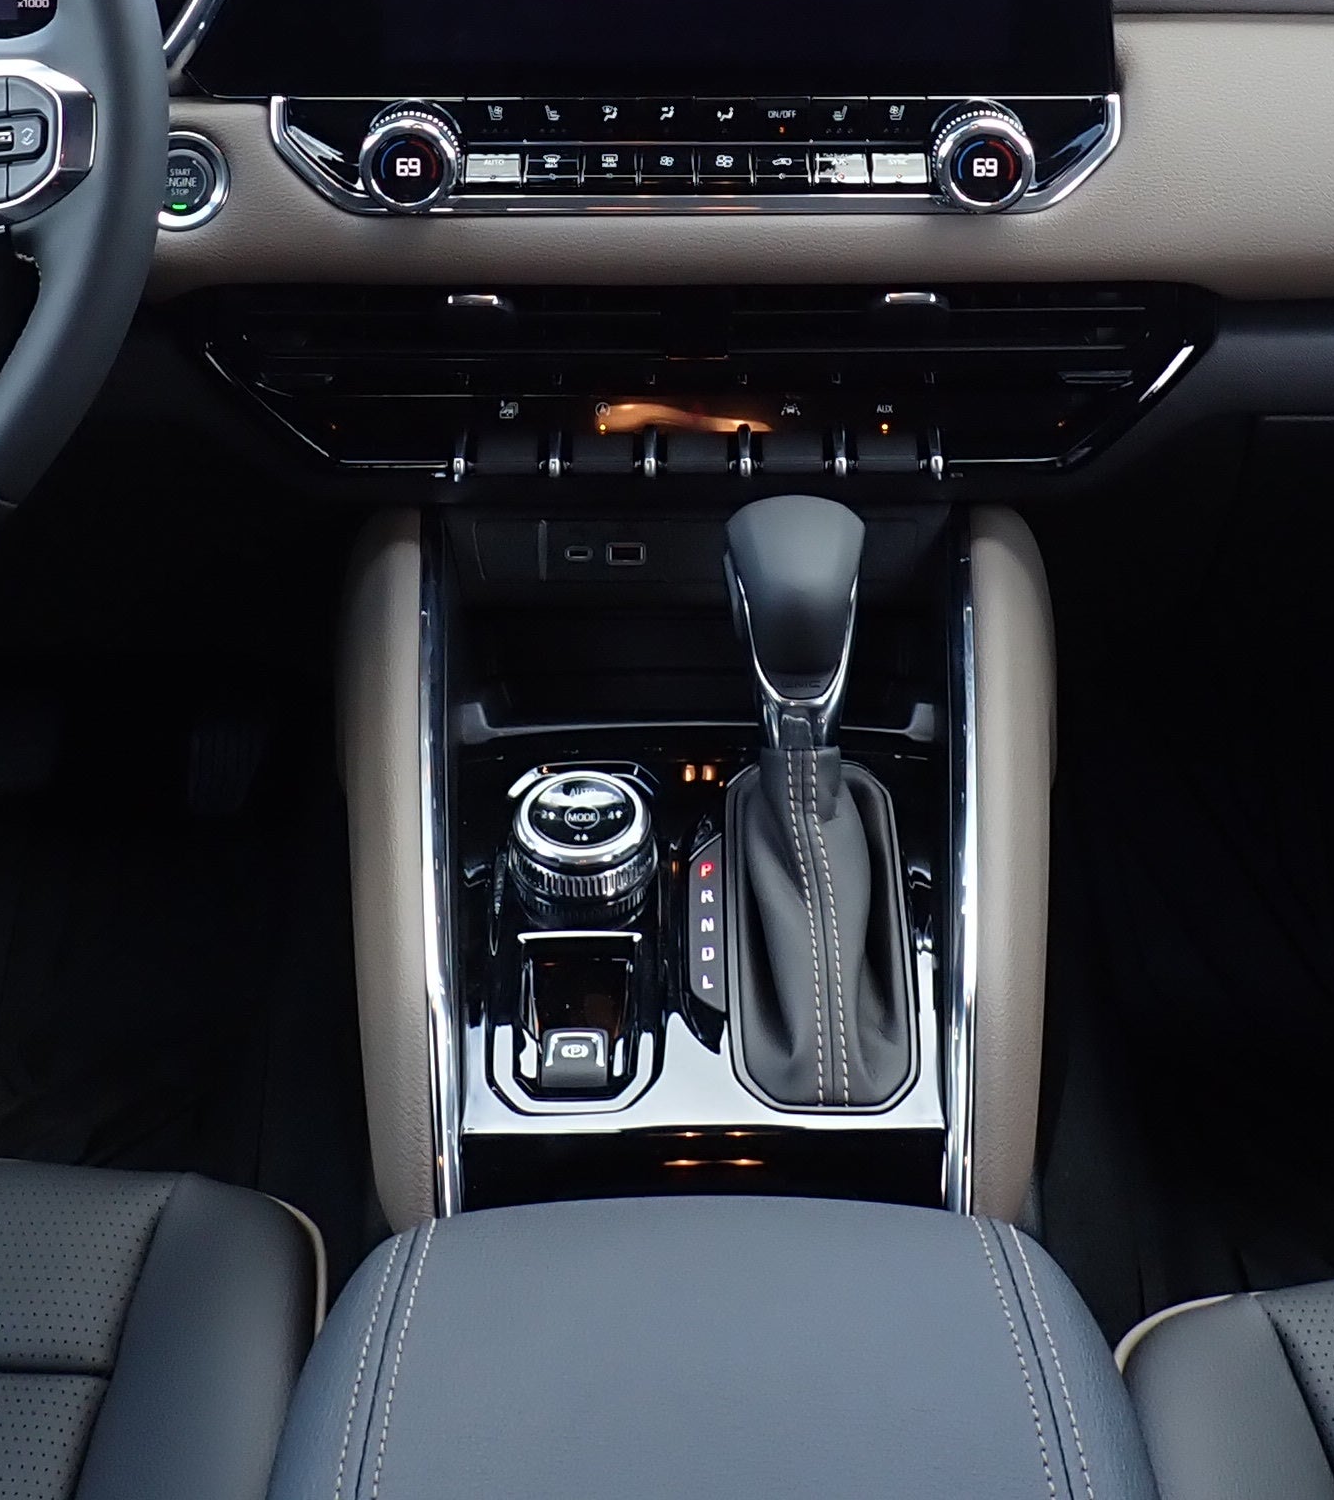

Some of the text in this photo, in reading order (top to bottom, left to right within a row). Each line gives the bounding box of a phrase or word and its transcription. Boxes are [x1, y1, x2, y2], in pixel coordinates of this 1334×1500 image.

[768, 110, 797, 120] ON/OFF
[170, 168, 191, 176] START
[395, 157, 421, 177] 69
[973, 157, 999, 177] 69
[171, 188, 190, 196] STOP
[877, 404, 894, 413] AUX
[568, 813, 597, 822] MODE
[701, 863, 714, 878] P
[701, 889, 714, 904] R
[701, 917, 714, 933] N
[701, 946, 714, 961] D
[701, 975, 714, 990] L
